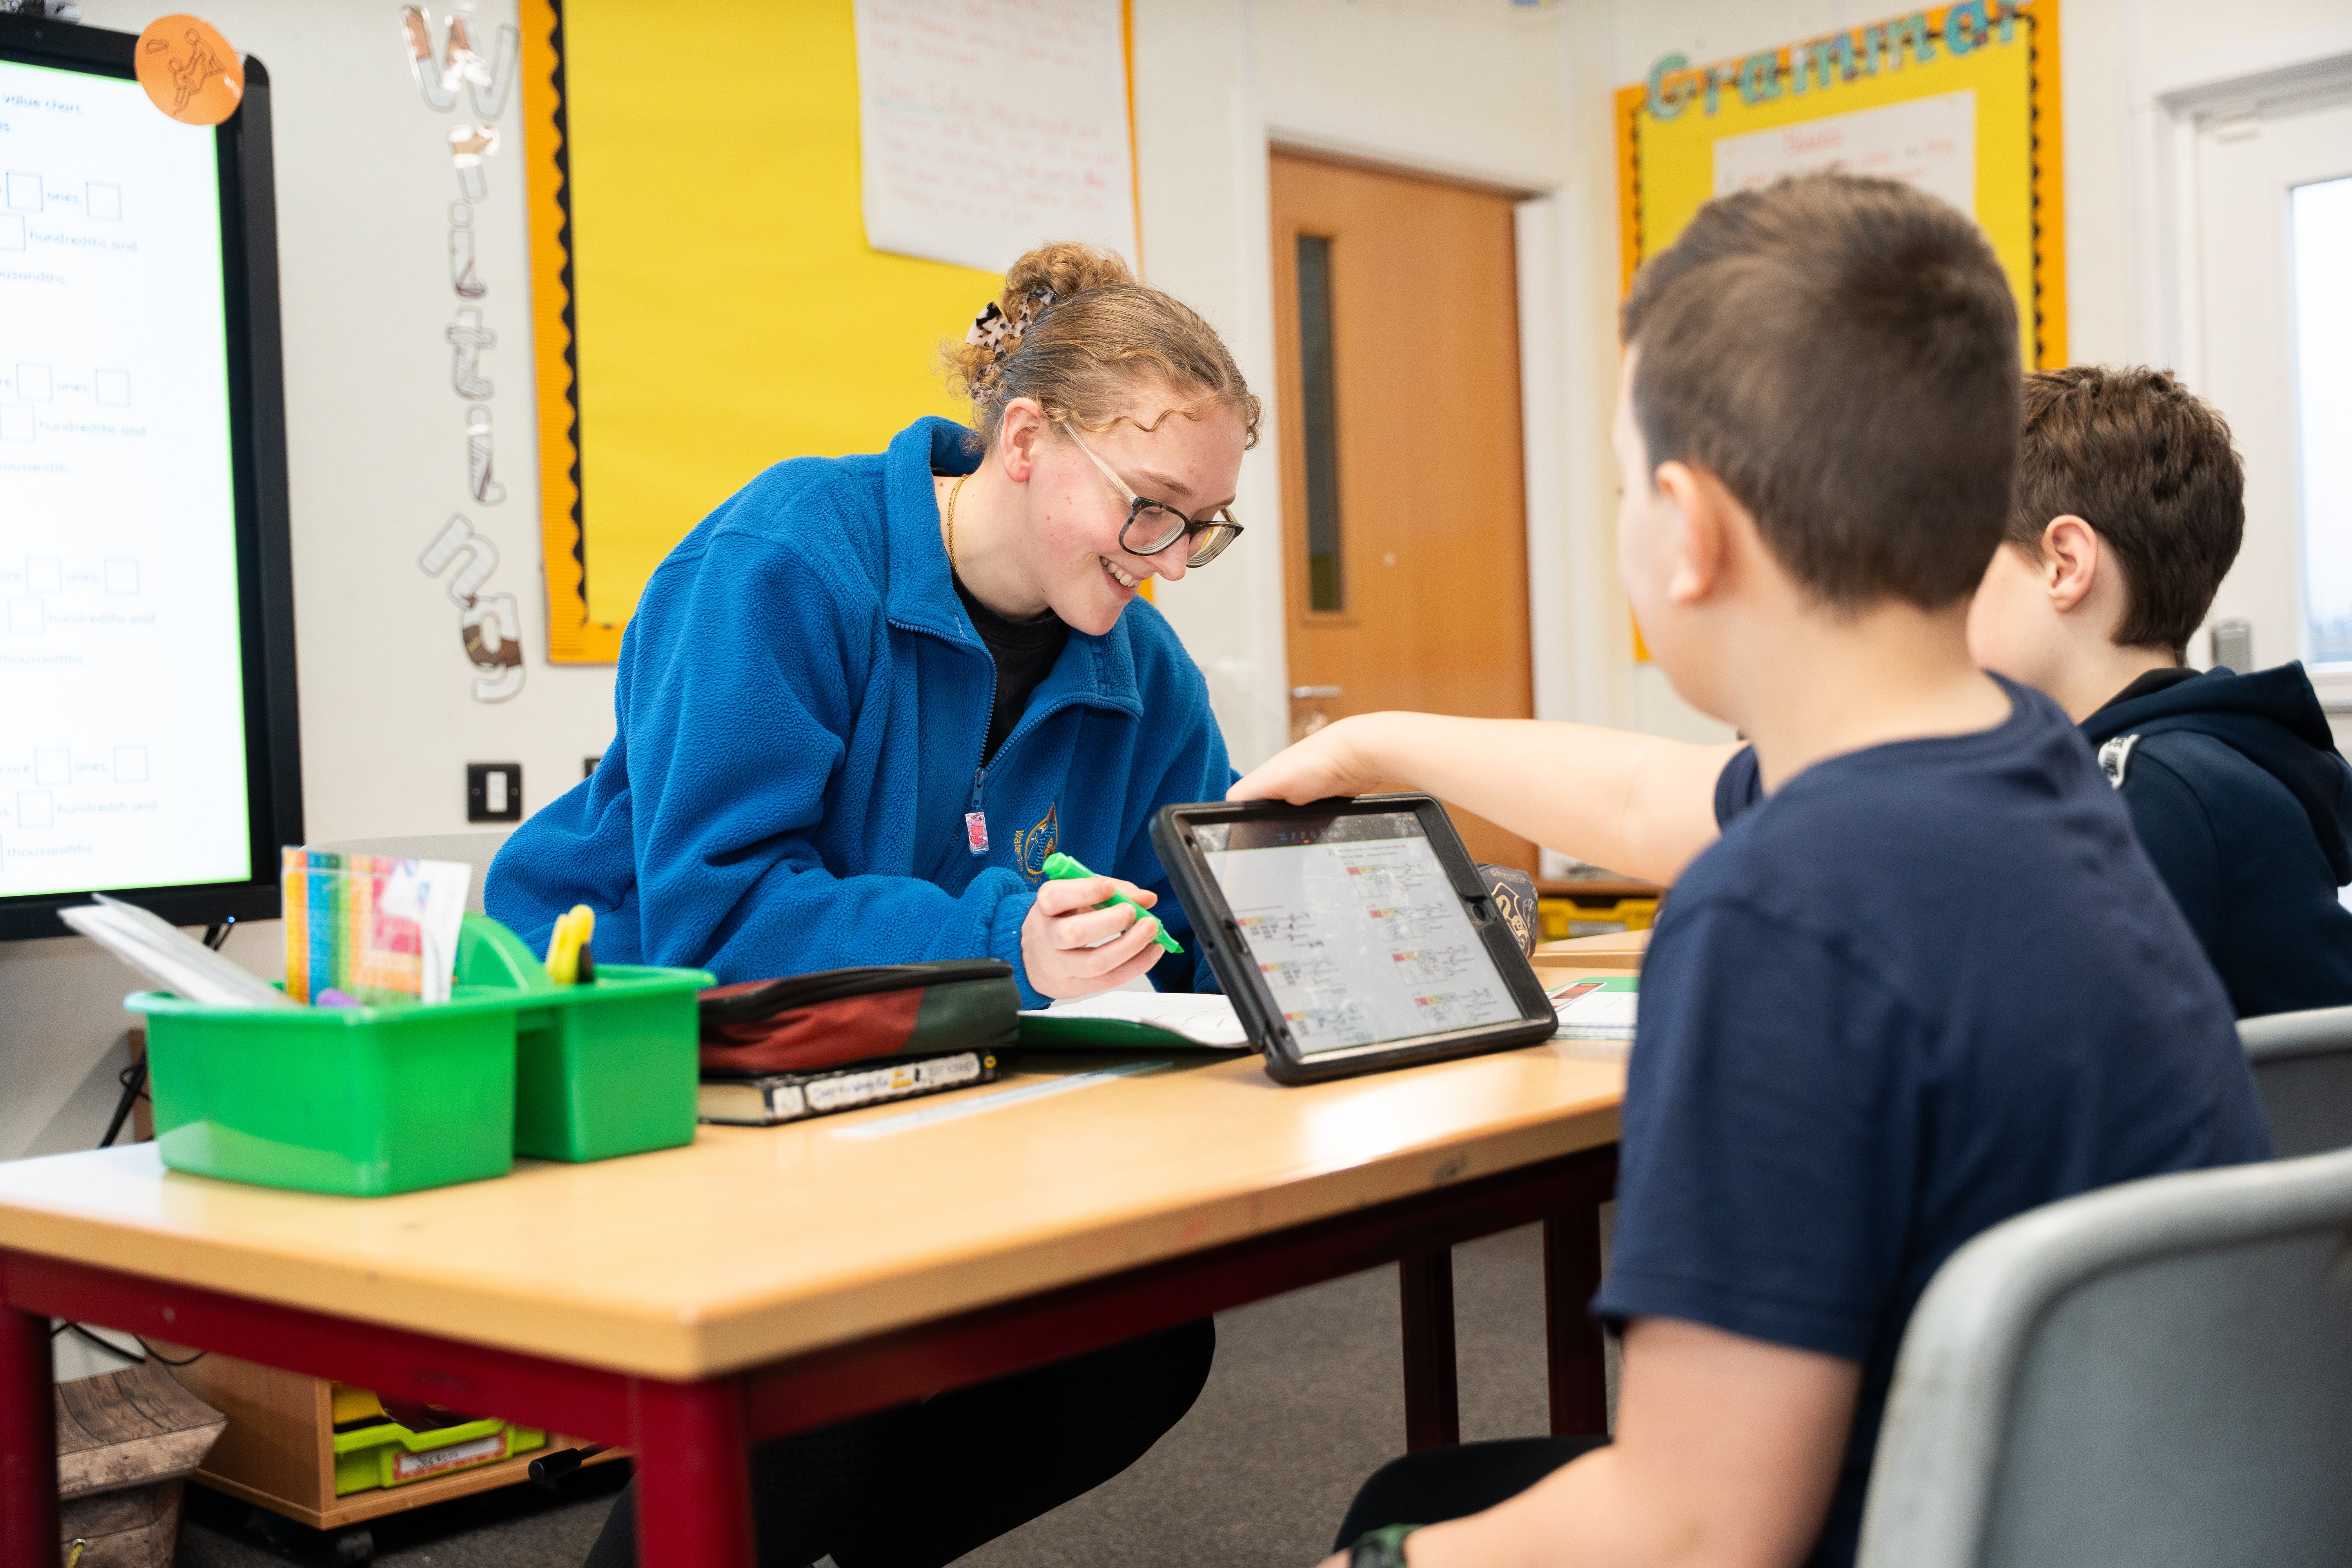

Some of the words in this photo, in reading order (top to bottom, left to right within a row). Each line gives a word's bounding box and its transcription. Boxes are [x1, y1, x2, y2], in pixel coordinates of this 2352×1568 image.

[1645, 0, 2024, 122] Grammar
[3, 93, 40, 109] value
[30, 229, 107, 249] hundredths
[112, 240, 137, 252] and
[399, 4, 526, 703] Writing
[39, 419, 116, 436] hundredths
[120, 426, 147, 438] and
[48, 612, 125, 626] hundredths
[129, 613, 156, 626] and
[131, 798, 158, 813] and
